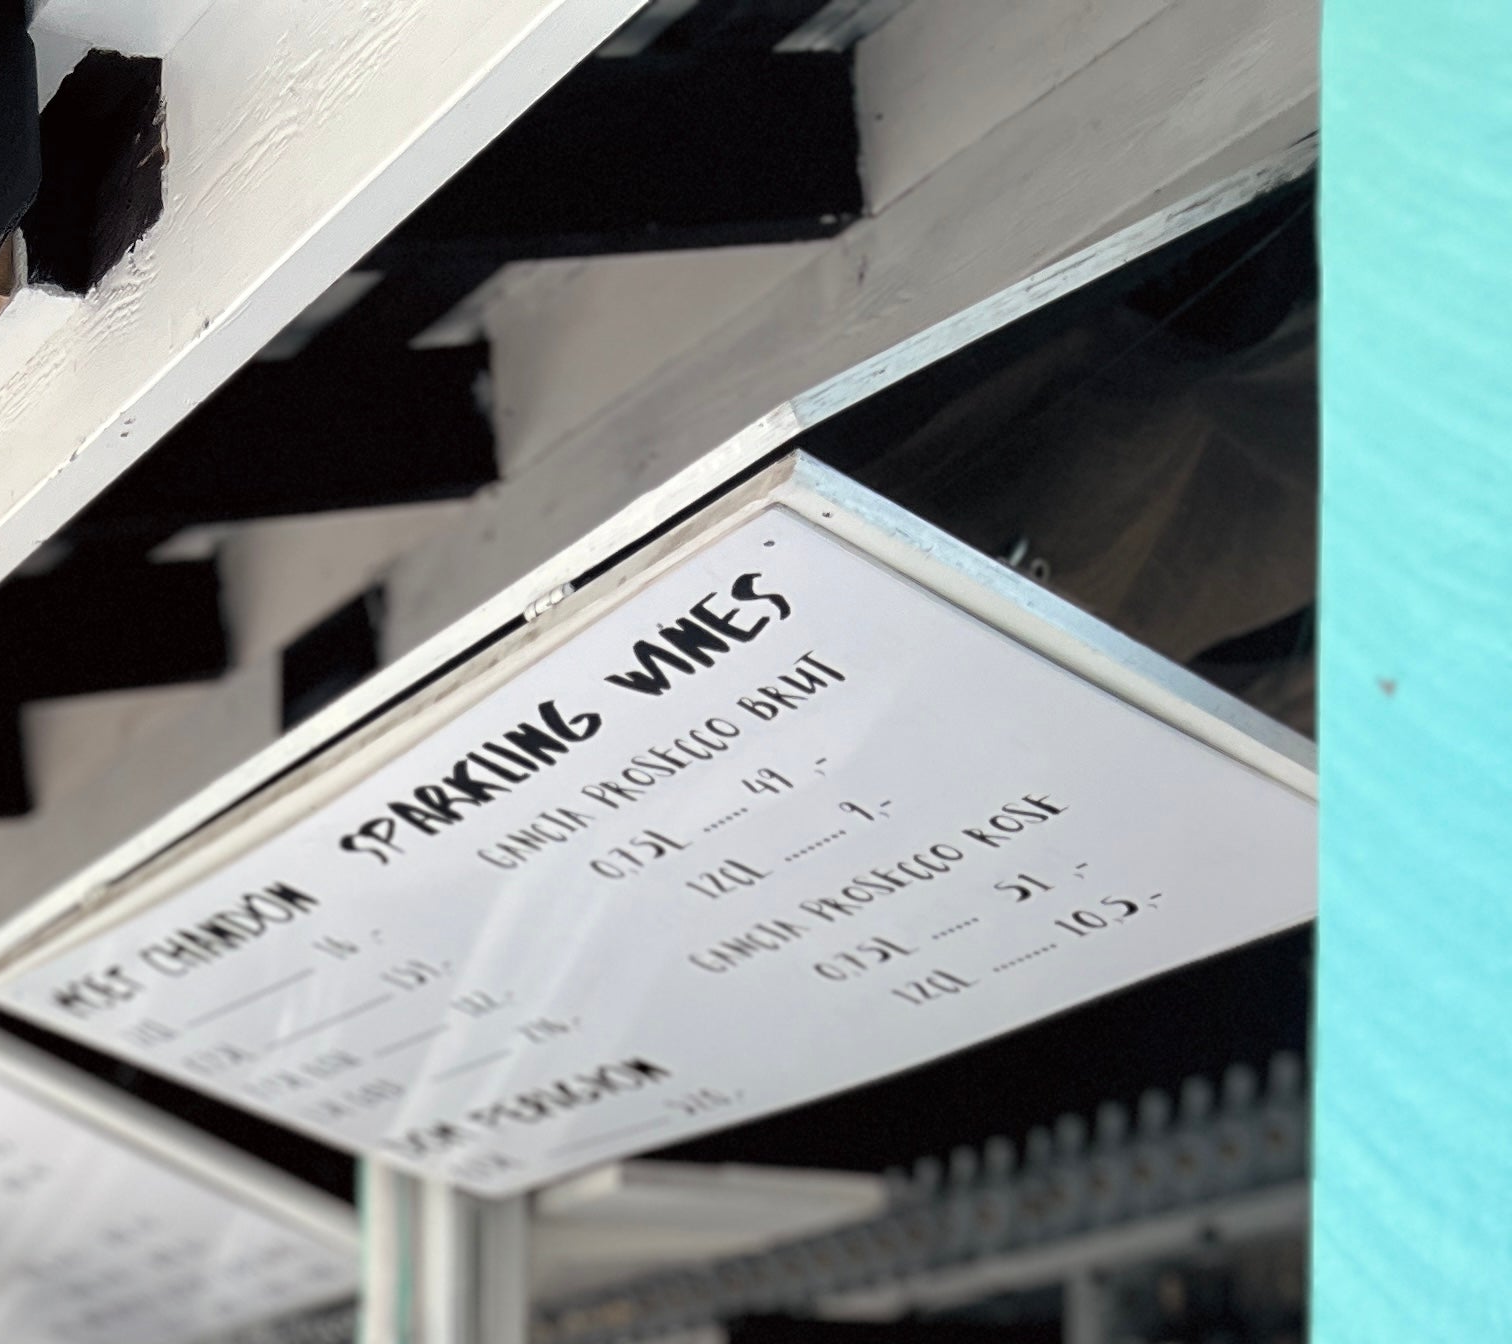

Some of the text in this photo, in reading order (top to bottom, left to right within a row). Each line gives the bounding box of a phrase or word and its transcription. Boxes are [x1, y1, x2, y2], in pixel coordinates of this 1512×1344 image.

[340, 573, 790, 865] SPARKLING WINES
[477, 650, 845, 871] GANCIA PROSECCO BRUT
[140, 881, 319, 978] CHANDON
[688, 792, 1069, 975] GANCIA PROSECCO ROSE
